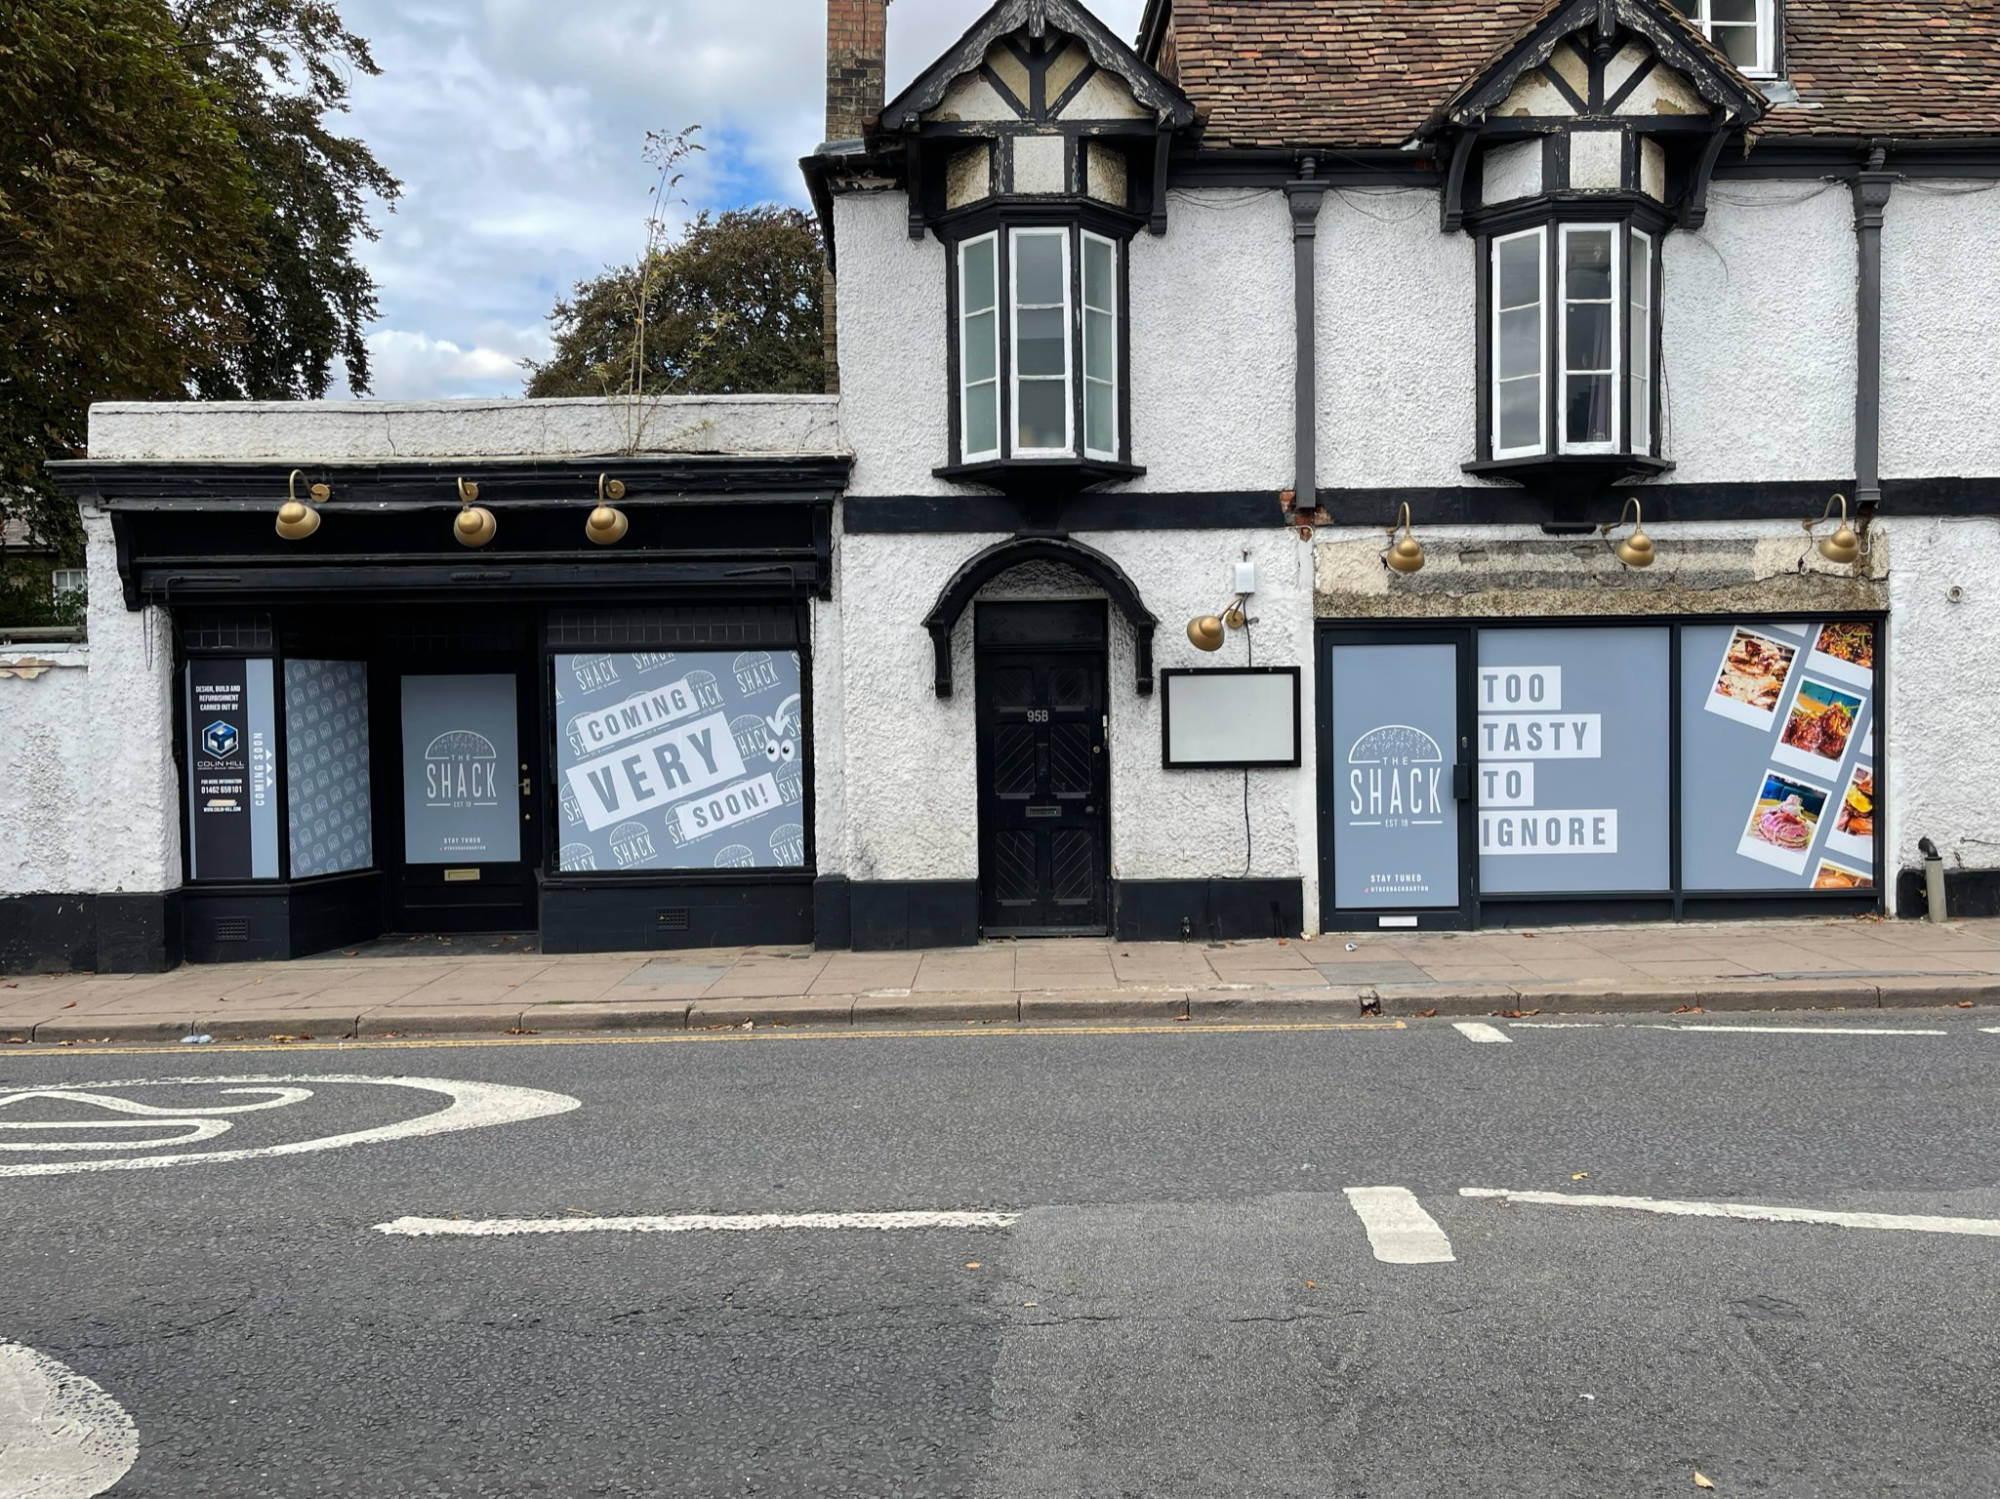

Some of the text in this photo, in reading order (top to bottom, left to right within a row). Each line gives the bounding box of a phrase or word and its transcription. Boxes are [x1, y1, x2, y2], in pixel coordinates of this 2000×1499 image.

[576, 658, 618, 690] SHACK
[736, 662, 780, 693] SHACK
[1482, 673, 1544, 703] TOO
[587, 688, 687, 742] COMING
[1482, 722, 1588, 752] TASTY
[253, 732, 265, 806] COMING SOON
[587, 727, 719, 814] VERY
[1382, 756, 1408, 766] THE
[426, 762, 497, 799] SHACK
[1350, 767, 1442, 815] SHACK
[1482, 770, 1522, 799] TO
[692, 783, 768, 828] SOON!
[1385, 818, 1397, 828] EST
[1483, 816, 1606, 848] IGNORE
[613, 834, 656, 866] SHACK
[1370, 874, 1422, 883] STAY TUNED
